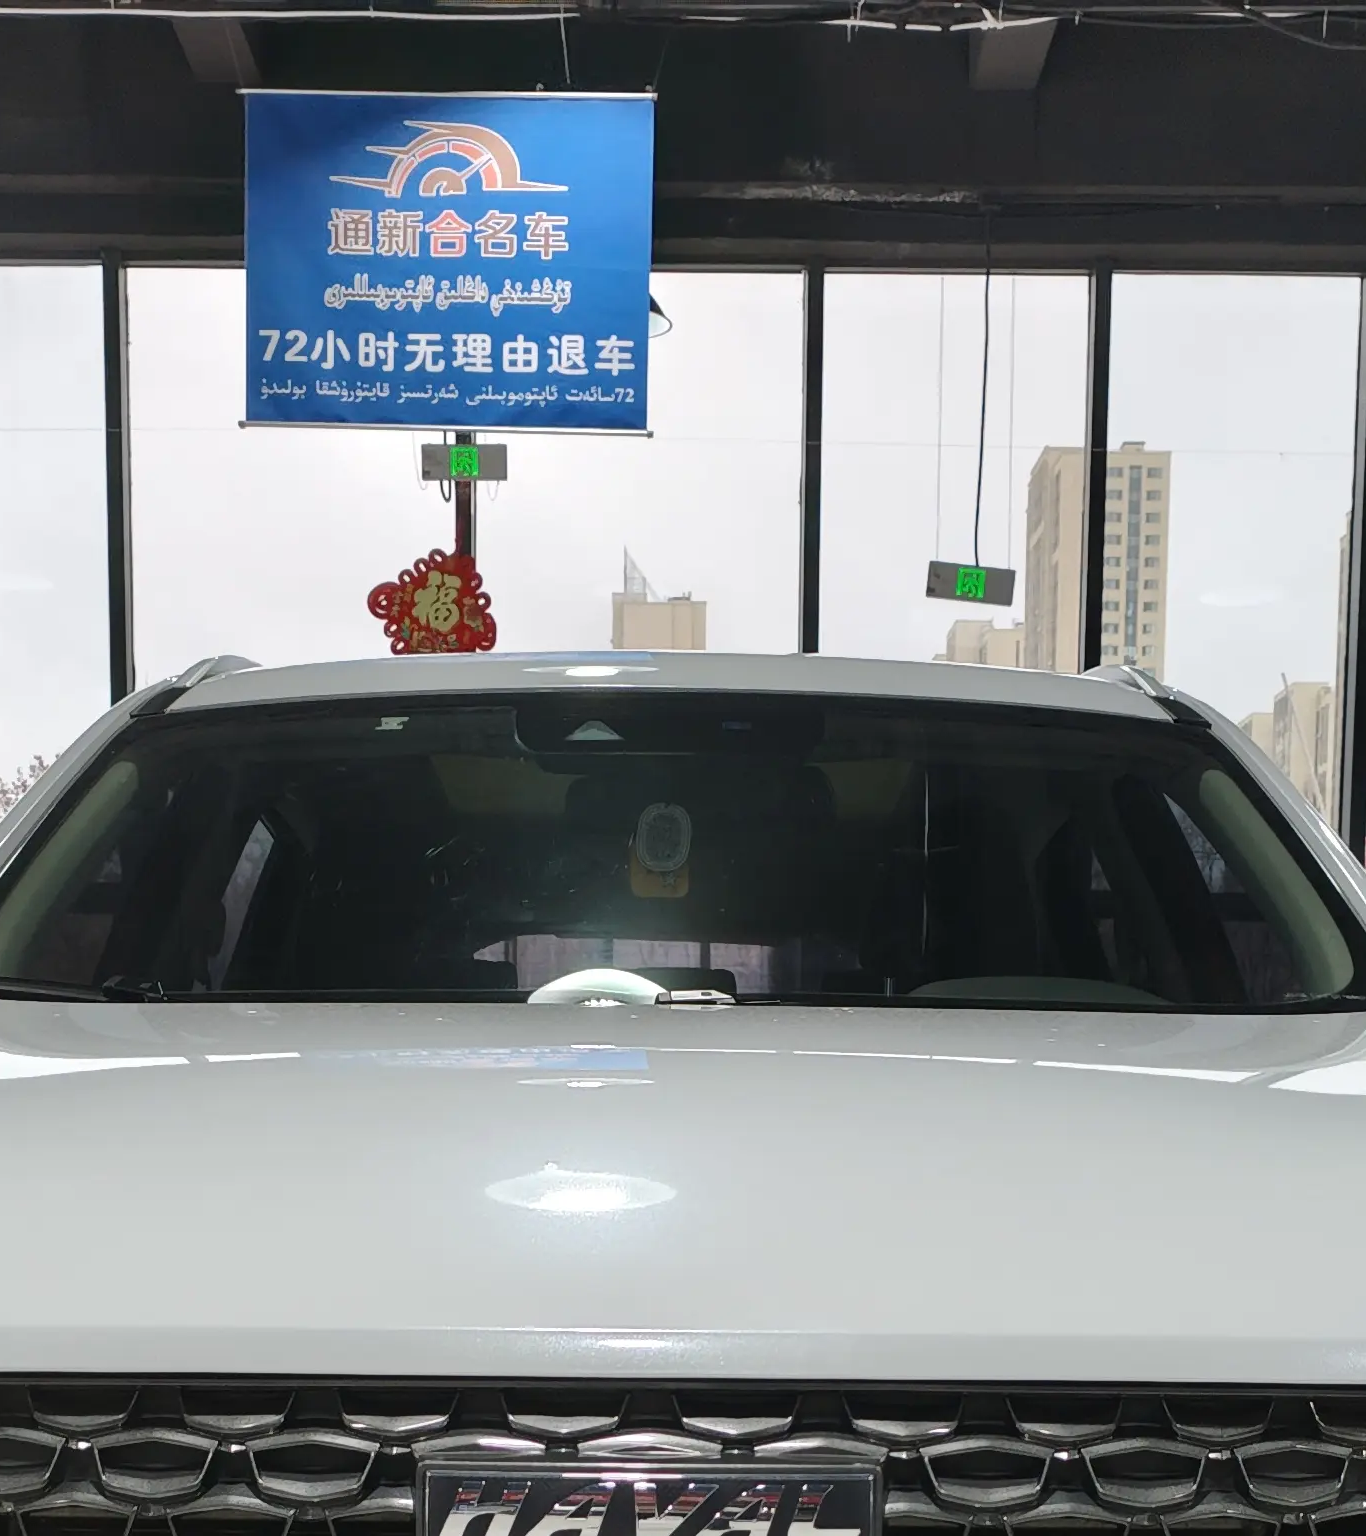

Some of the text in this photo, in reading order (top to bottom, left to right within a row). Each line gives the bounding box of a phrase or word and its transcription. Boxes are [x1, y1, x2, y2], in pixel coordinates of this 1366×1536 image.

[327, 208, 569, 260] 通新合名车
[258, 329, 635, 376] 72小时无理由退车
